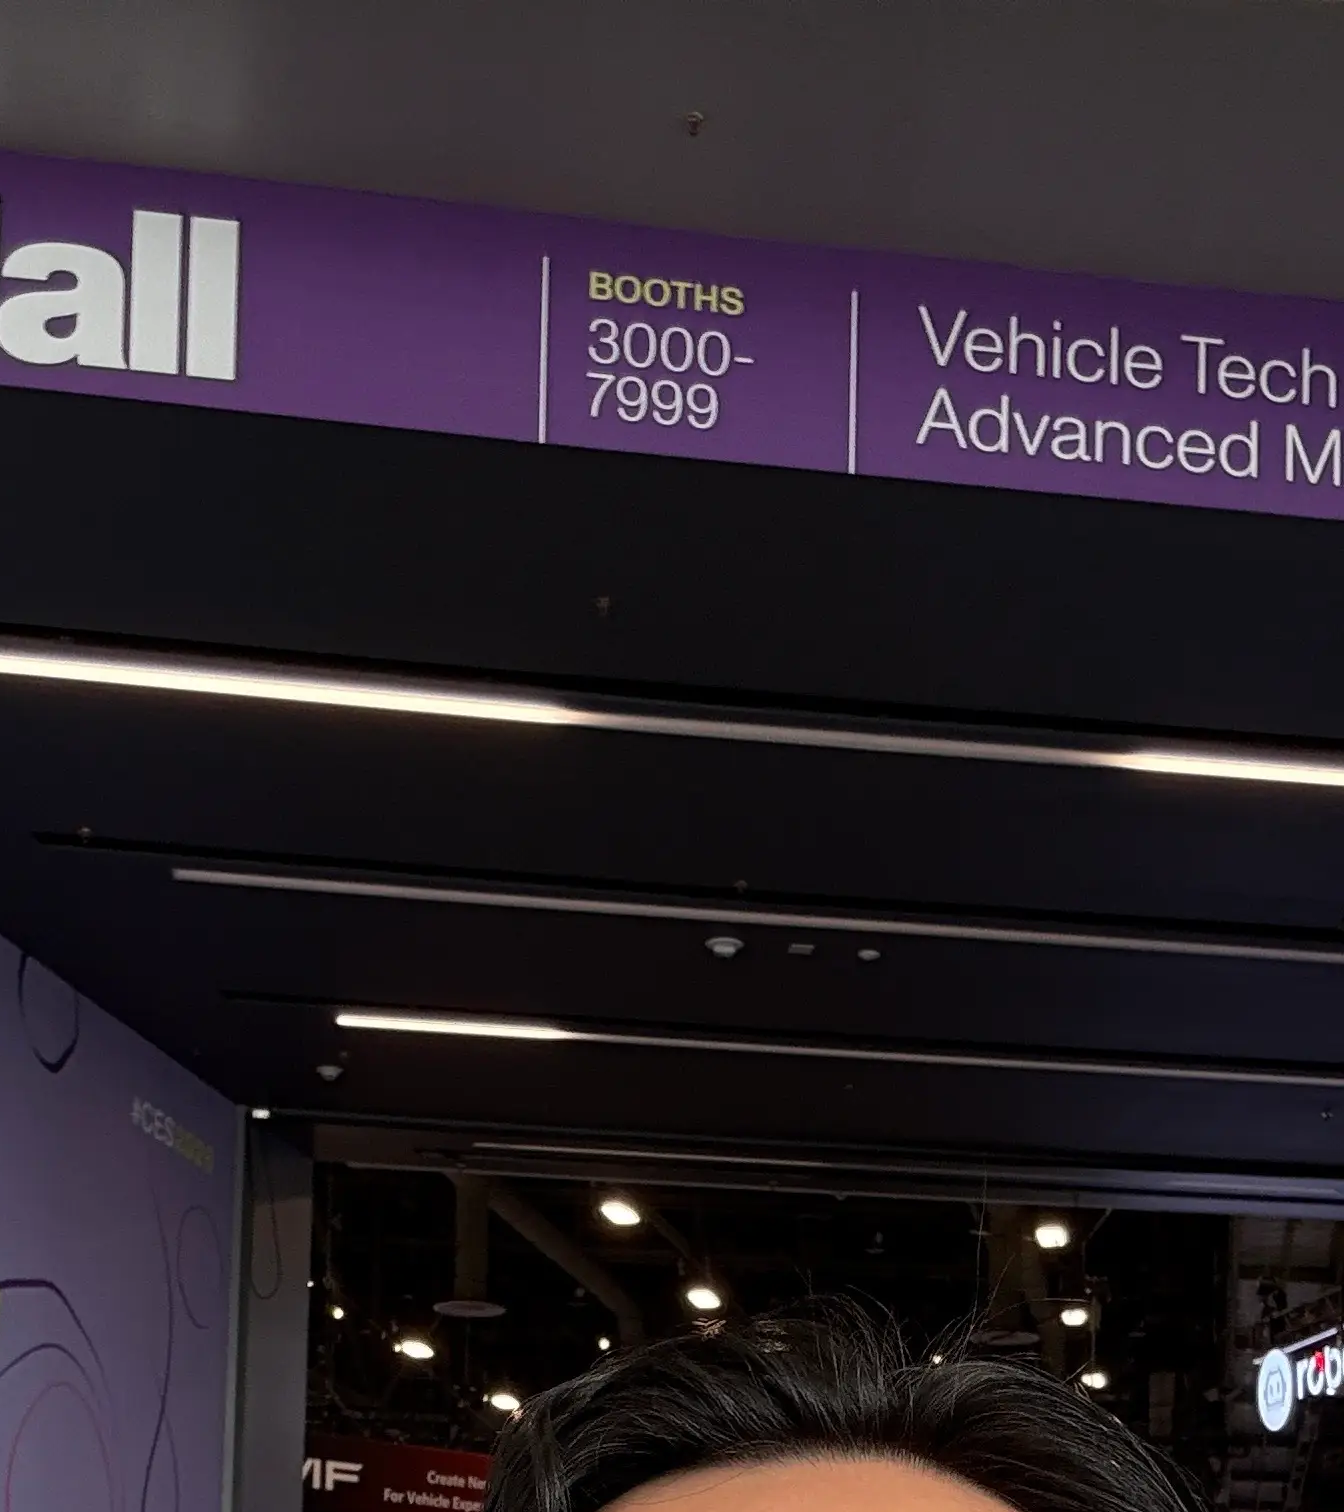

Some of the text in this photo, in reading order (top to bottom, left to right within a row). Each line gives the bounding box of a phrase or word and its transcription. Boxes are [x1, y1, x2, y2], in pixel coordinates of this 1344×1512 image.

[588, 271, 744, 316] BOOTHS
[587, 318, 755, 377] 3000-
[917, 305, 1163, 389] Vehicle
[1180, 334, 1337, 409] Tech
[585, 369, 719, 430] 7999
[915, 386, 1259, 479] Advanced
[383, 1488, 406, 1503] For
[407, 1490, 451, 1509] Vehicle
[426, 1470, 465, 1488] Create
